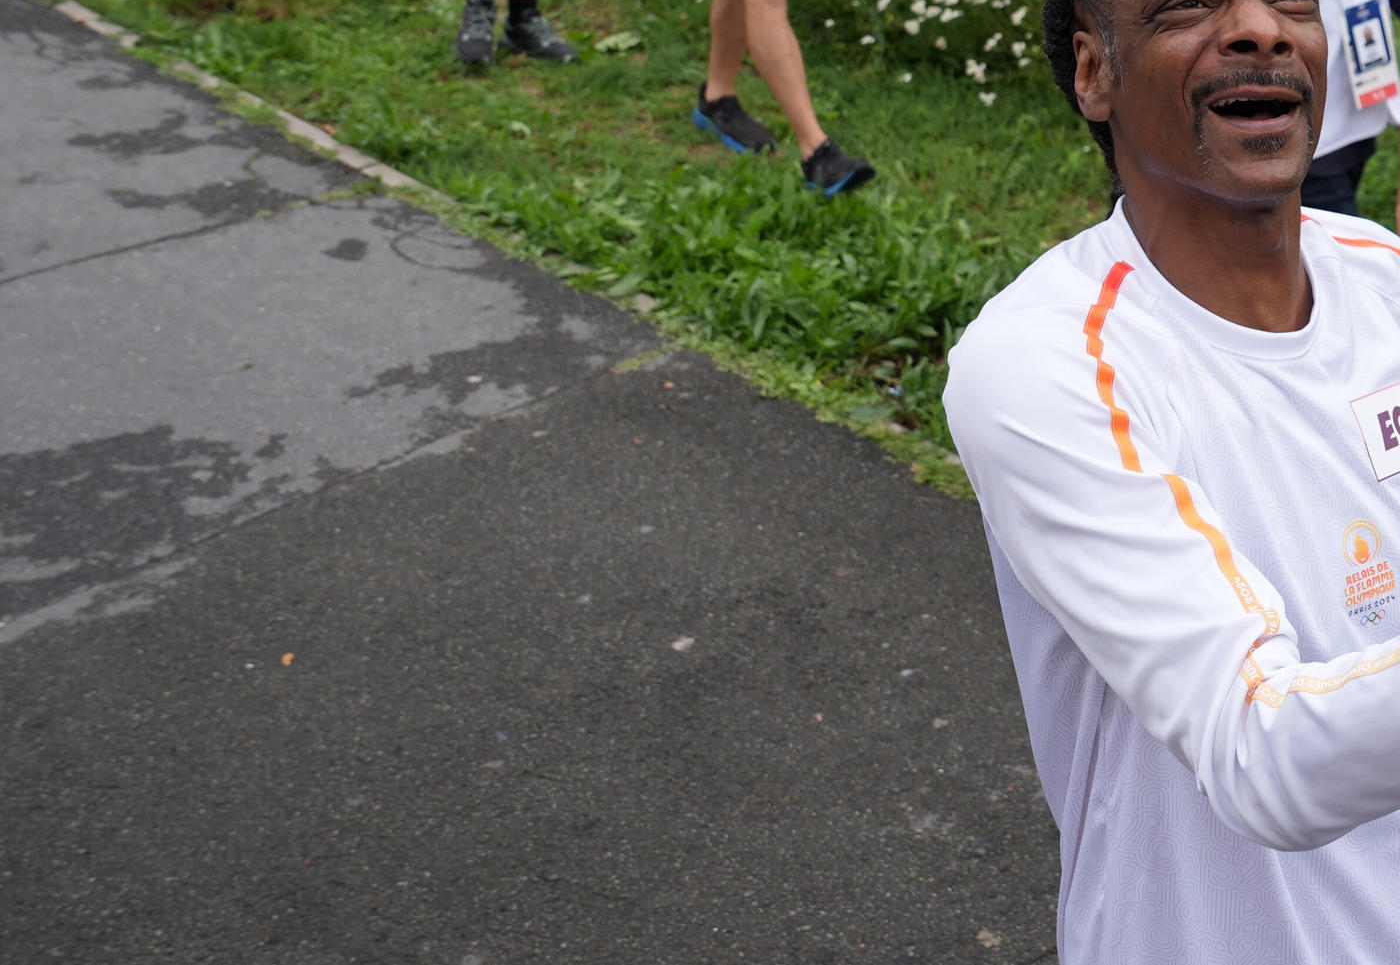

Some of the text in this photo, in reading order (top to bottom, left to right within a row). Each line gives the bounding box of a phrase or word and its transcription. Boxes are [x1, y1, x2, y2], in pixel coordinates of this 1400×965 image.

[1344, 569, 1395, 597] LA FLAMME
[1346, 560, 1390, 585] RELAIS DE
[1345, 579, 1397, 607] OLYMPIQUE
[1374, 595, 1396, 607] 2024
